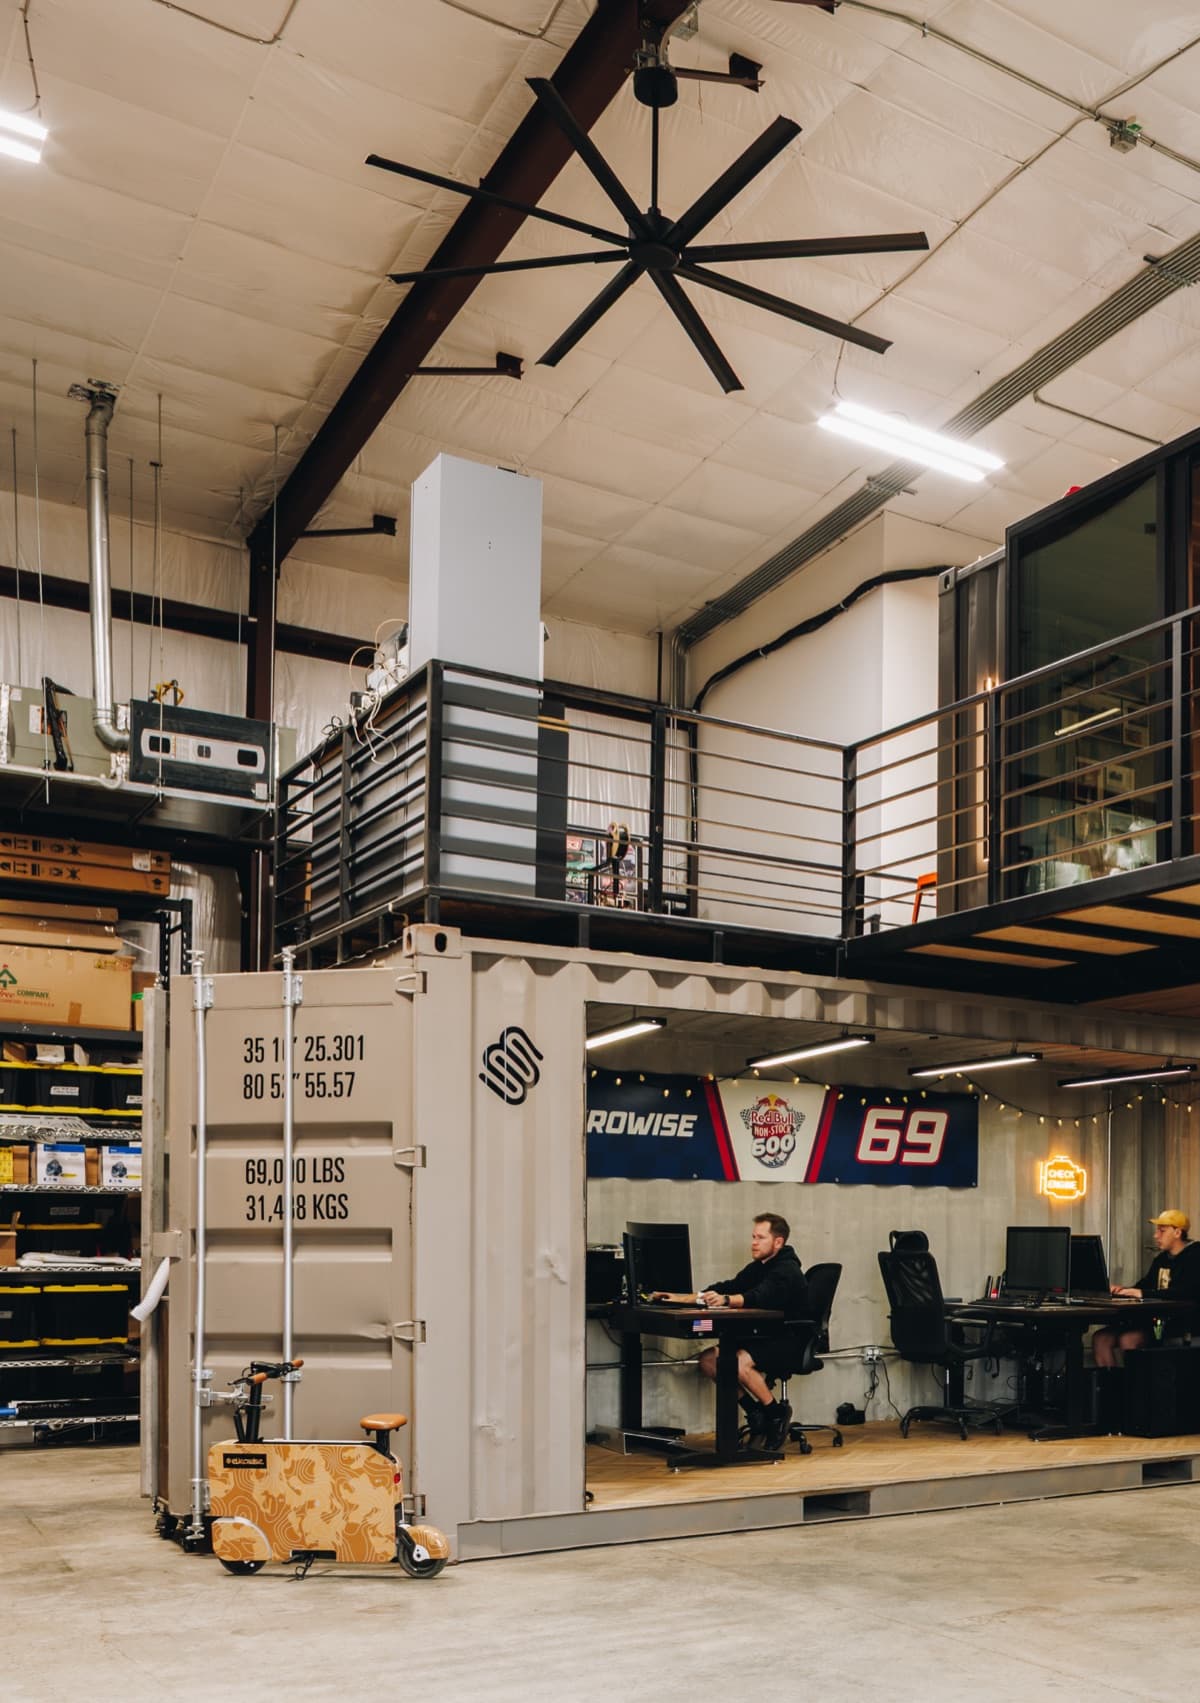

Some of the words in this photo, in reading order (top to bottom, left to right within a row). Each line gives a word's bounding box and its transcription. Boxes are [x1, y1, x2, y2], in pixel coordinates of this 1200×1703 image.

[243, 1037, 265, 1064] 35
[304, 1035, 364, 1062] 25.301
[243, 1073, 264, 1100] 80
[305, 1071, 355, 1099] 55.57
[752, 1110, 772, 1123] Red
[775, 1111, 794, 1123] Bull
[857, 1105, 949, 1166] 69
[245, 1157, 306, 1186] 69,00
[312, 1157, 345, 1183] LBS
[246, 1194, 306, 1223] 31,48
[312, 1193, 349, 1220] KGS
